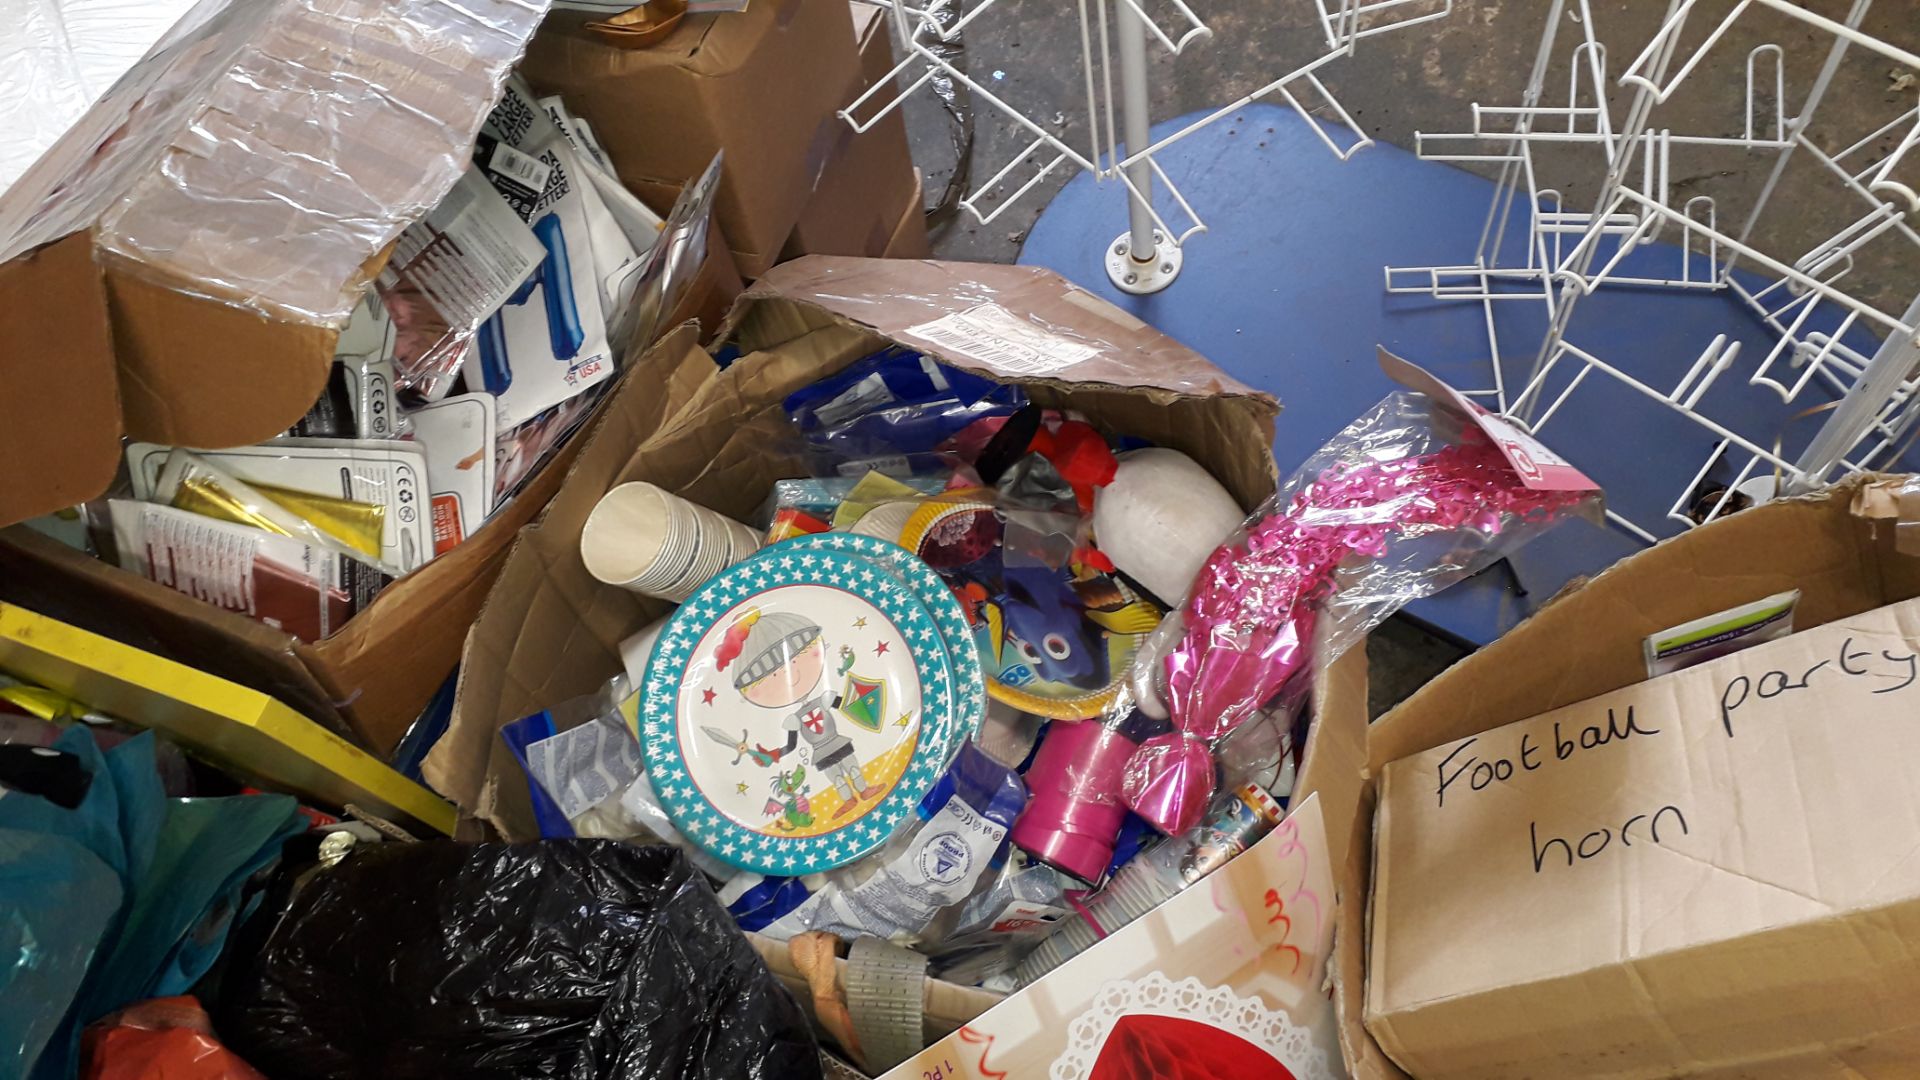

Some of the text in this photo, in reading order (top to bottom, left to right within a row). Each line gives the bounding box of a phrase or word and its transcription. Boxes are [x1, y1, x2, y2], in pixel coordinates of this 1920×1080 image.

[499, 94, 526, 141] LARGE
[537, 179, 571, 211] ETTER!
[579, 362, 601, 378] USA
[1437, 637, 1917, 808] Football party
[1530, 805, 1689, 873] horn
